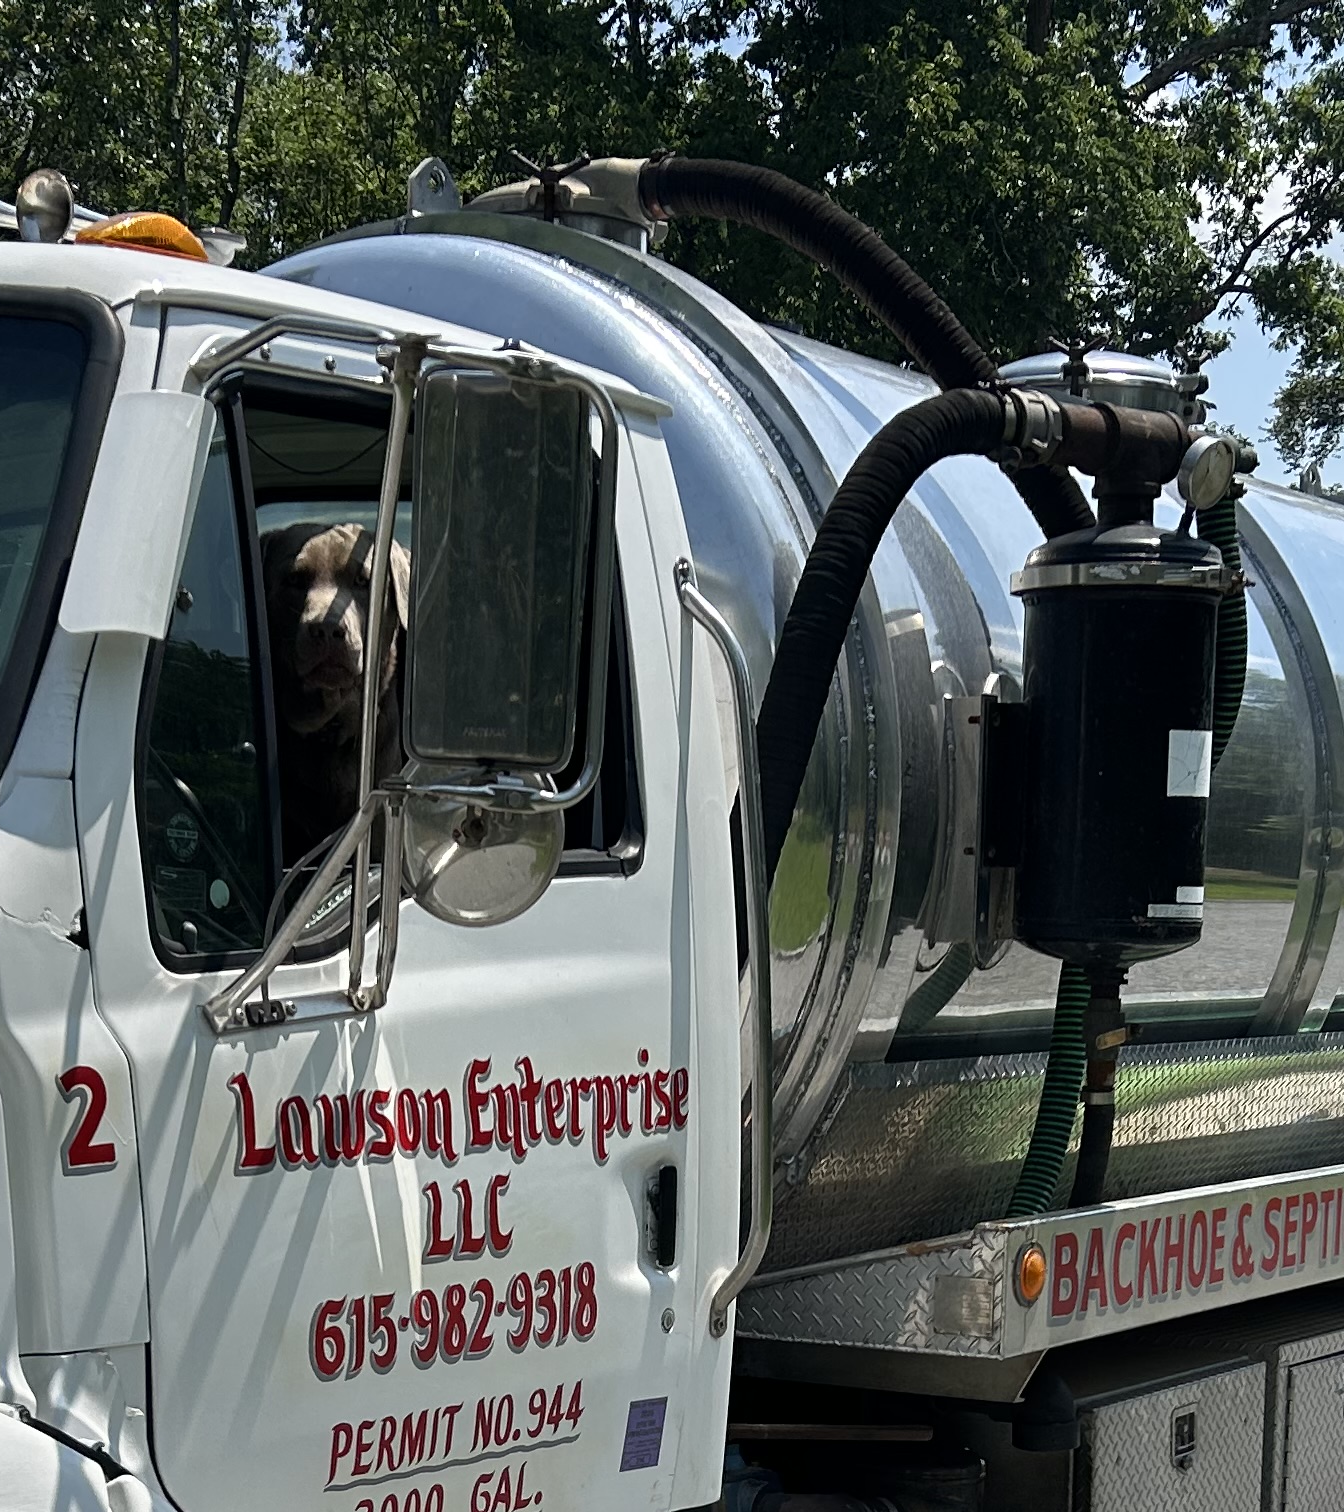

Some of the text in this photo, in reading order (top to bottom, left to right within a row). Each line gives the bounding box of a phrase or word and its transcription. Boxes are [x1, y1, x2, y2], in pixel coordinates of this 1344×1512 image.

[58, 1065, 117, 1172] 2
[228, 1048, 689, 1173] Lawson Enterprise
[423, 1171, 514, 1263] LLC
[1048, 1207, 1227, 1322] BACKHOE
[1230, 1202, 1255, 1281] &
[325, 1401, 464, 1487] PERMIT
[469, 1394, 521, 1453] NO.
[526, 1378, 586, 1439] 944
